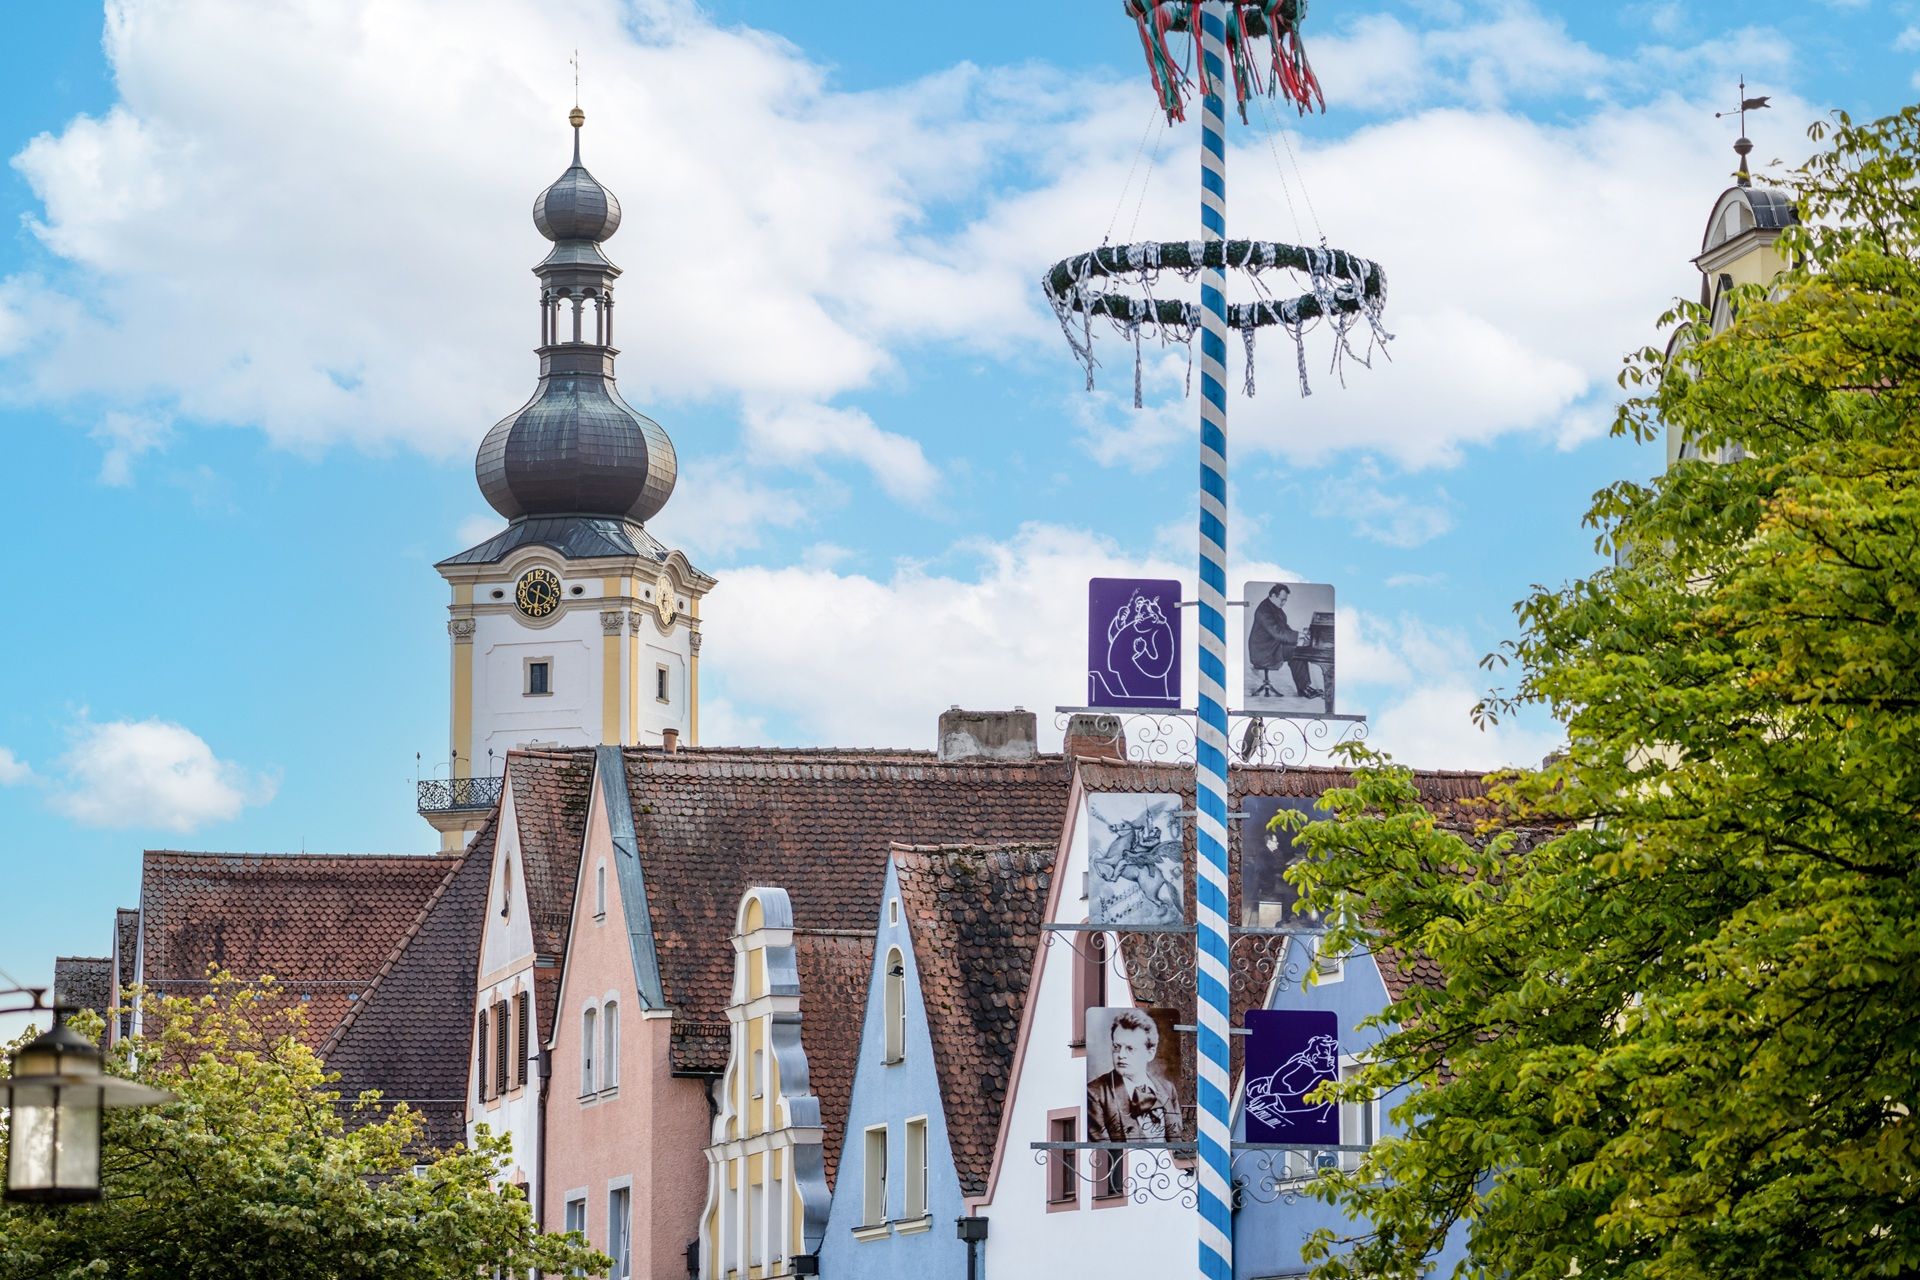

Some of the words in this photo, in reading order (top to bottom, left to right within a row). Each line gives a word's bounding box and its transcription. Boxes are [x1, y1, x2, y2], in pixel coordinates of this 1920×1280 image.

[528, 571, 534, 582] 11
[535, 570, 544, 579] 12
[519, 580, 528, 589] 10
[550, 578, 557, 588] 2
[518, 589, 526, 598] 9
[552, 588, 560, 597] 3
[520, 598, 526, 608] 8
[549, 597, 557, 607] 4
[527, 605, 532, 614] 7
[534, 607, 542, 616] 6
[543, 604, 550, 614] 5
